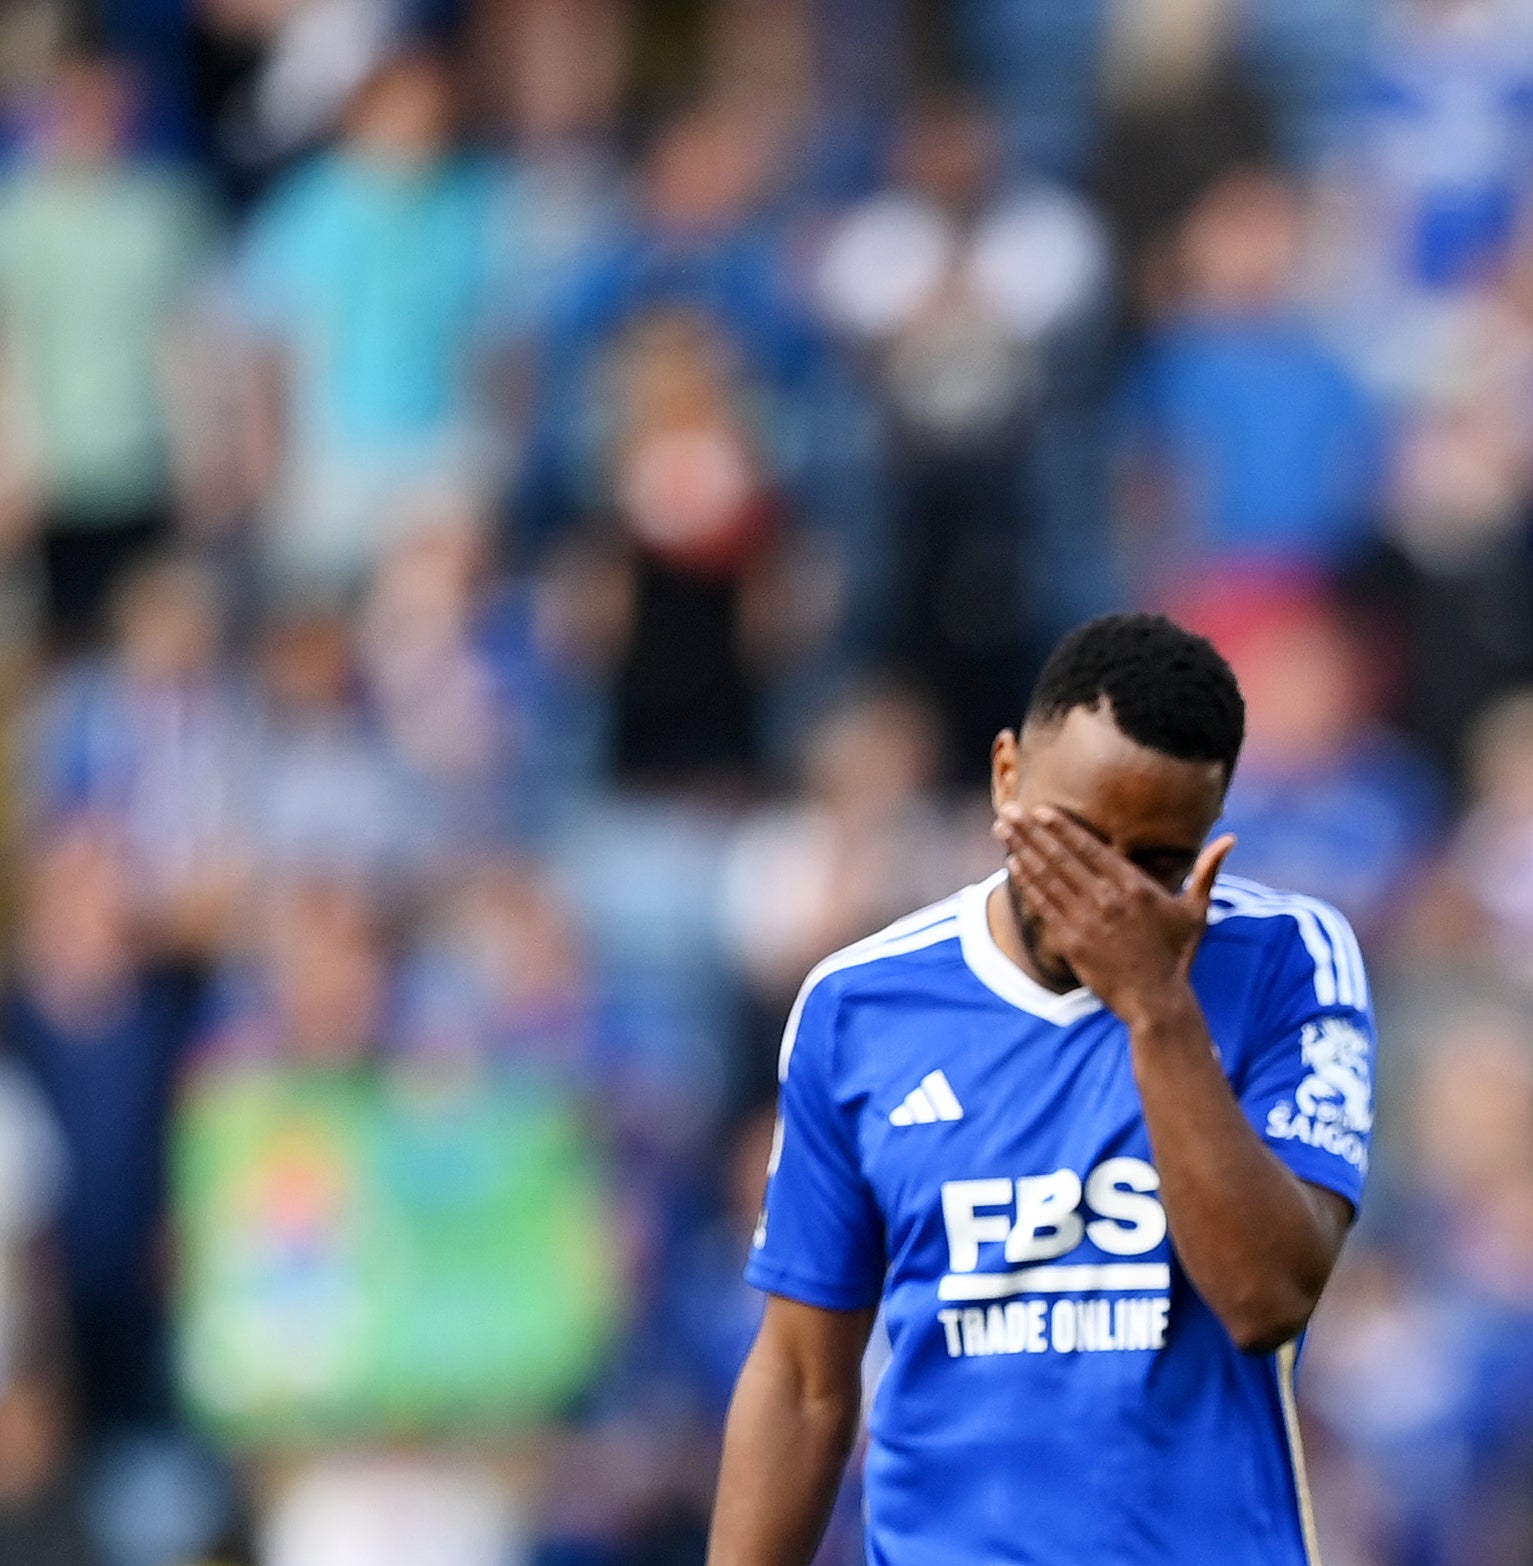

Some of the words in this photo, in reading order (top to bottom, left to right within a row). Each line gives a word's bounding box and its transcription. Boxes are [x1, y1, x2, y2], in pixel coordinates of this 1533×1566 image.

[941, 1156, 1168, 1274] FBS
[937, 1300, 1049, 1358] TRADE
[1051, 1297, 1171, 1354] ONLINE
